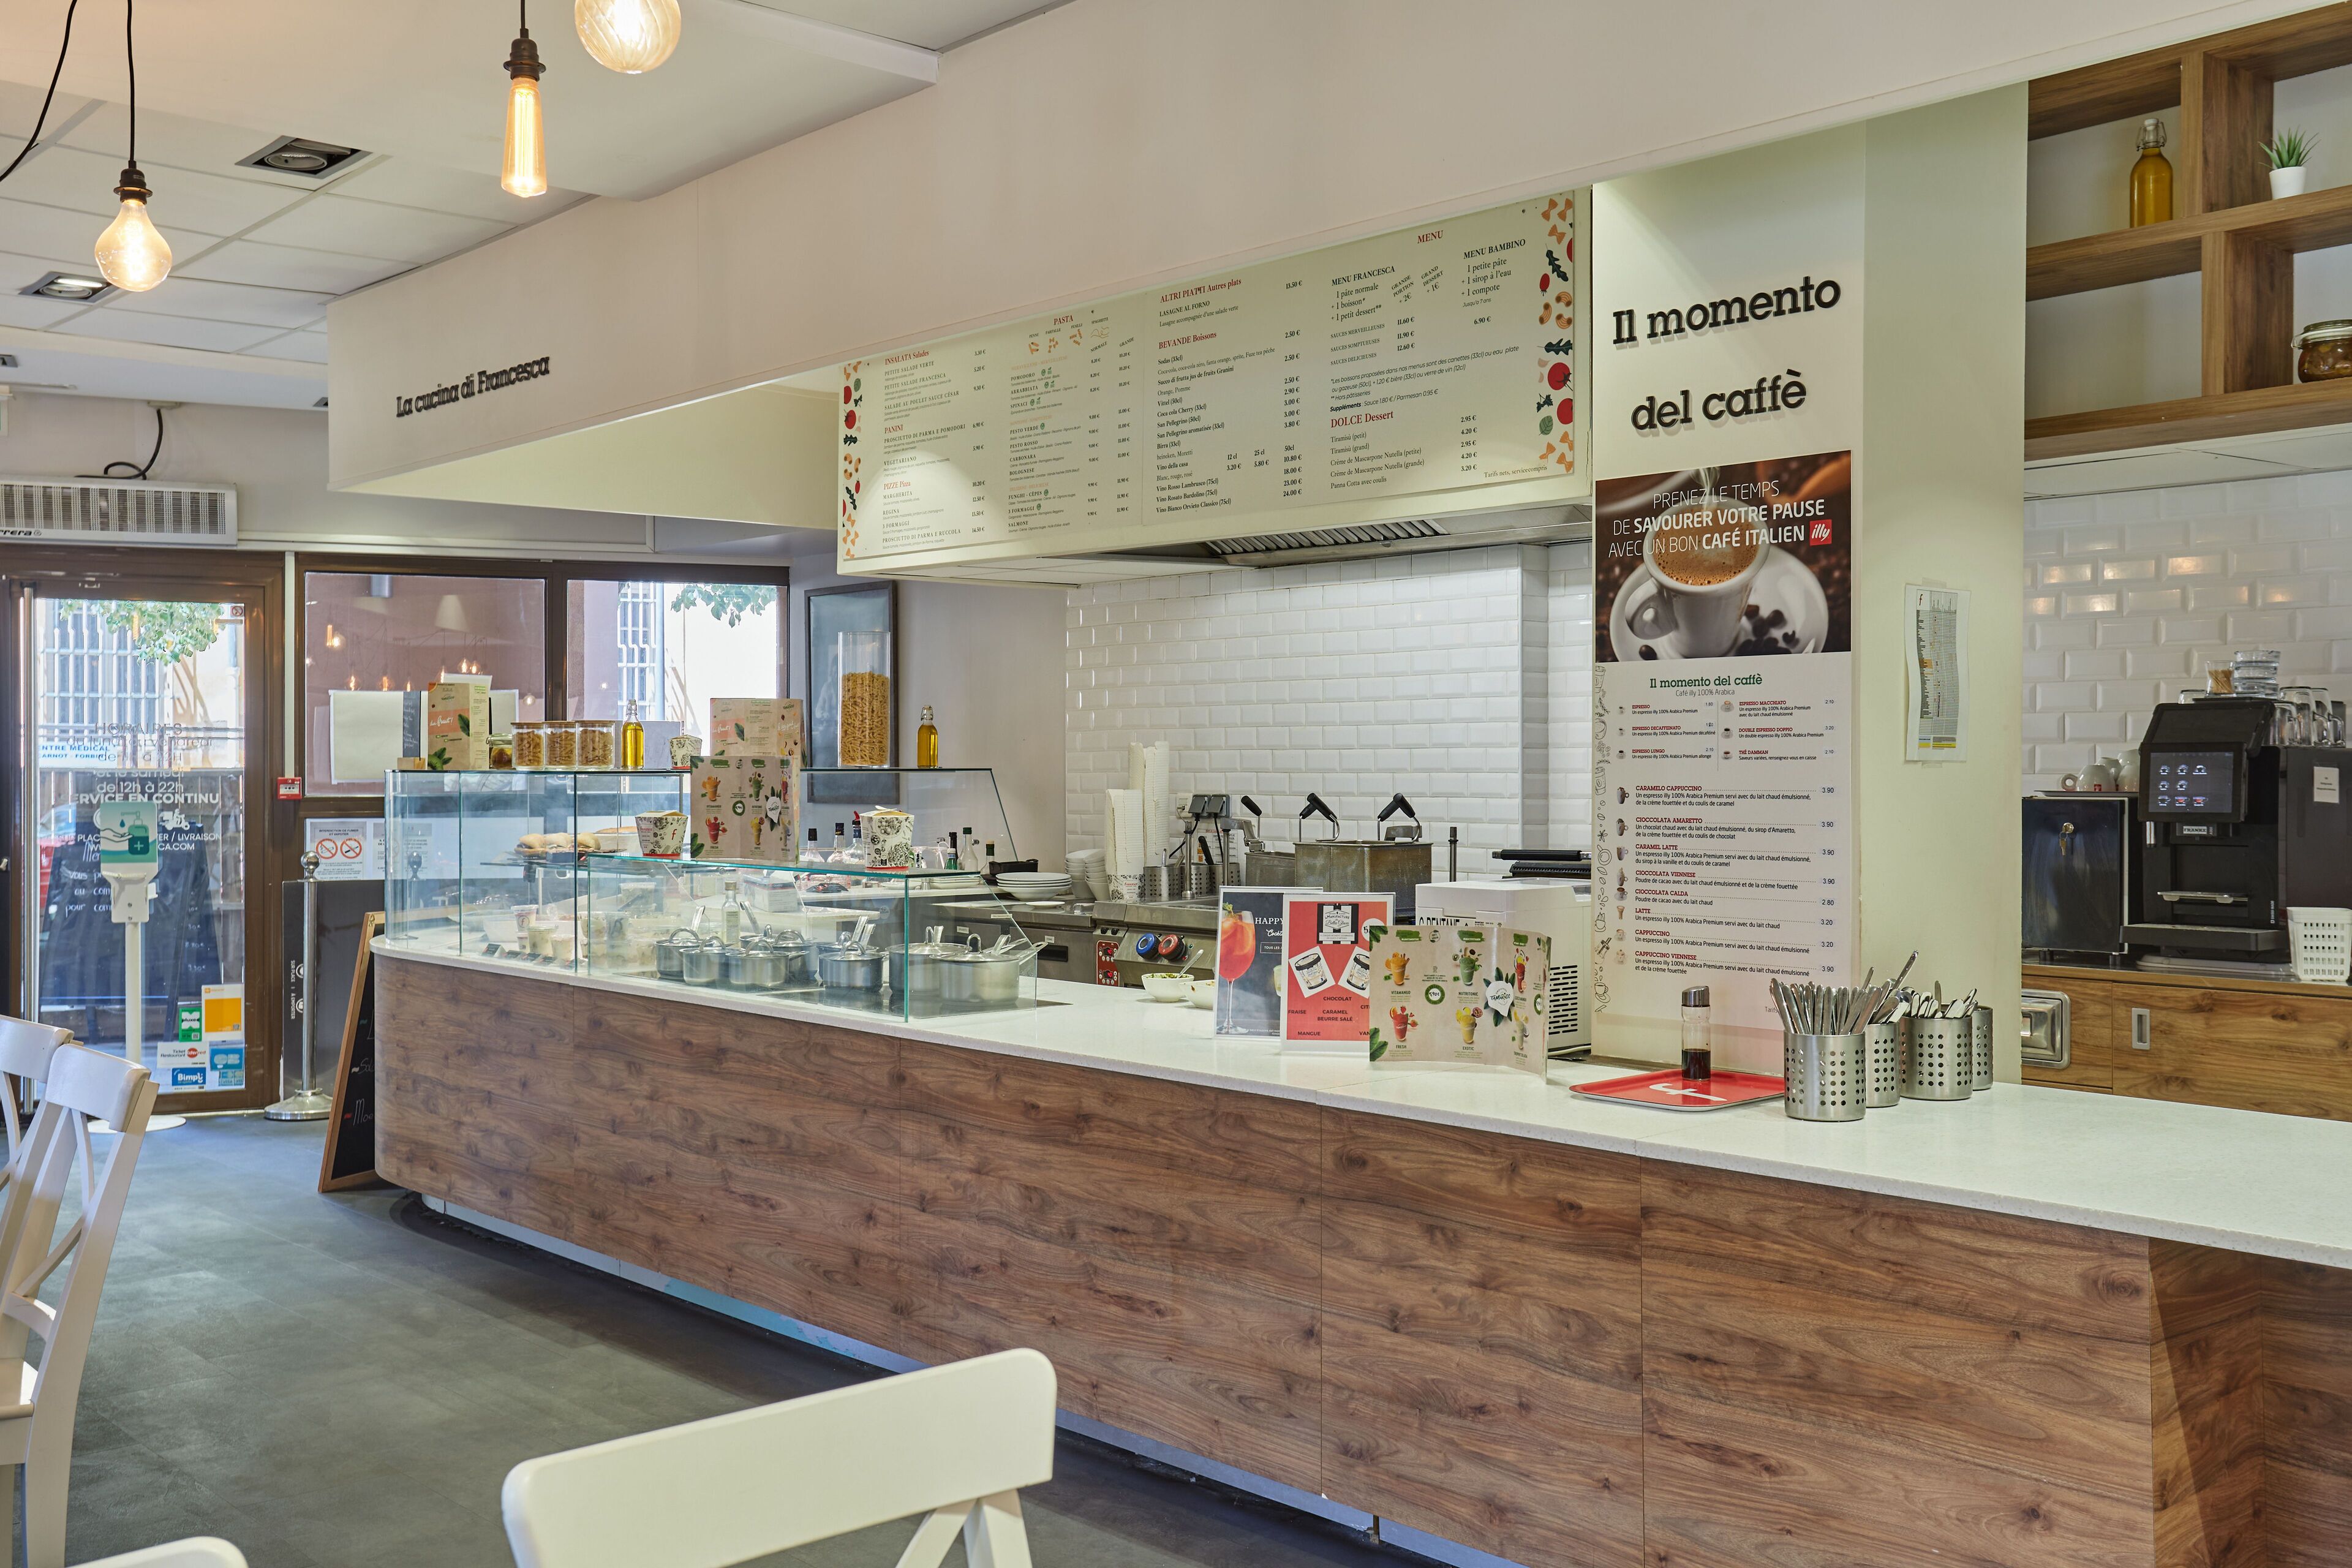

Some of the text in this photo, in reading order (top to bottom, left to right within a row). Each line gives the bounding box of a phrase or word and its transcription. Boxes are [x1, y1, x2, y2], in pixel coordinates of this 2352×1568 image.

[1417, 230, 1443, 244] MENU
[1463, 238, 1526, 260] MENU BAMBINO
[1472, 261, 1491, 273] petite
[1493, 258, 1509, 270] pâte
[1332, 265, 1395, 287] MENU FRANCESCA
[1160, 279, 1242, 303] ALTRI PIATTI Autres plats
[1159, 306, 1183, 317] LASAGNE
[1191, 300, 1210, 310] FORNO
[1613, 276, 1841, 344] Il momento
[1054, 315, 1073, 325] PASTA
[1159, 333, 1216, 350] BEVANDE Boissons
[885, 350, 929, 366] INSALATA Salades
[884, 368, 900, 377] PETITE
[901, 364, 918, 373] SALADE
[396, 356, 550, 418] La cucina di Francesca
[1170, 396, 1183, 405] (50cl)
[1632, 369, 1806, 431] del caffè
[1166, 418, 1188, 427] Pellegrino
[1188, 415, 1201, 424] (50cl)
[1331, 411, 1393, 428] DOLCE Dessert
[884, 424, 903, 434] PANINI
[1352, 431, 1366, 442] (petit)
[884, 456, 917, 466] VEGETARIANO
[1009, 454, 1036, 462] CARBONARA
[1009, 467, 1035, 476] BOLOGNESE
[884, 481, 899, 490] PIZZE
[883, 491, 913, 500] MARGHERITA
[1653, 481, 1779, 509] PRENEZ LE TEMPS
[1613, 499, 1825, 536] DE SAVOURER VOTRE PAUSE
[1811, 523, 1831, 540] illy
[1608, 525, 1805, 559] AVEC UN BON CAFÉ ITALIEN
[1649, 673, 1763, 688] Il momento del caffè
[94, 722, 183, 735] HORAIRES
[97, 782, 184, 793] de 12h à 22h
[153, 793, 219, 804] CONTINU
